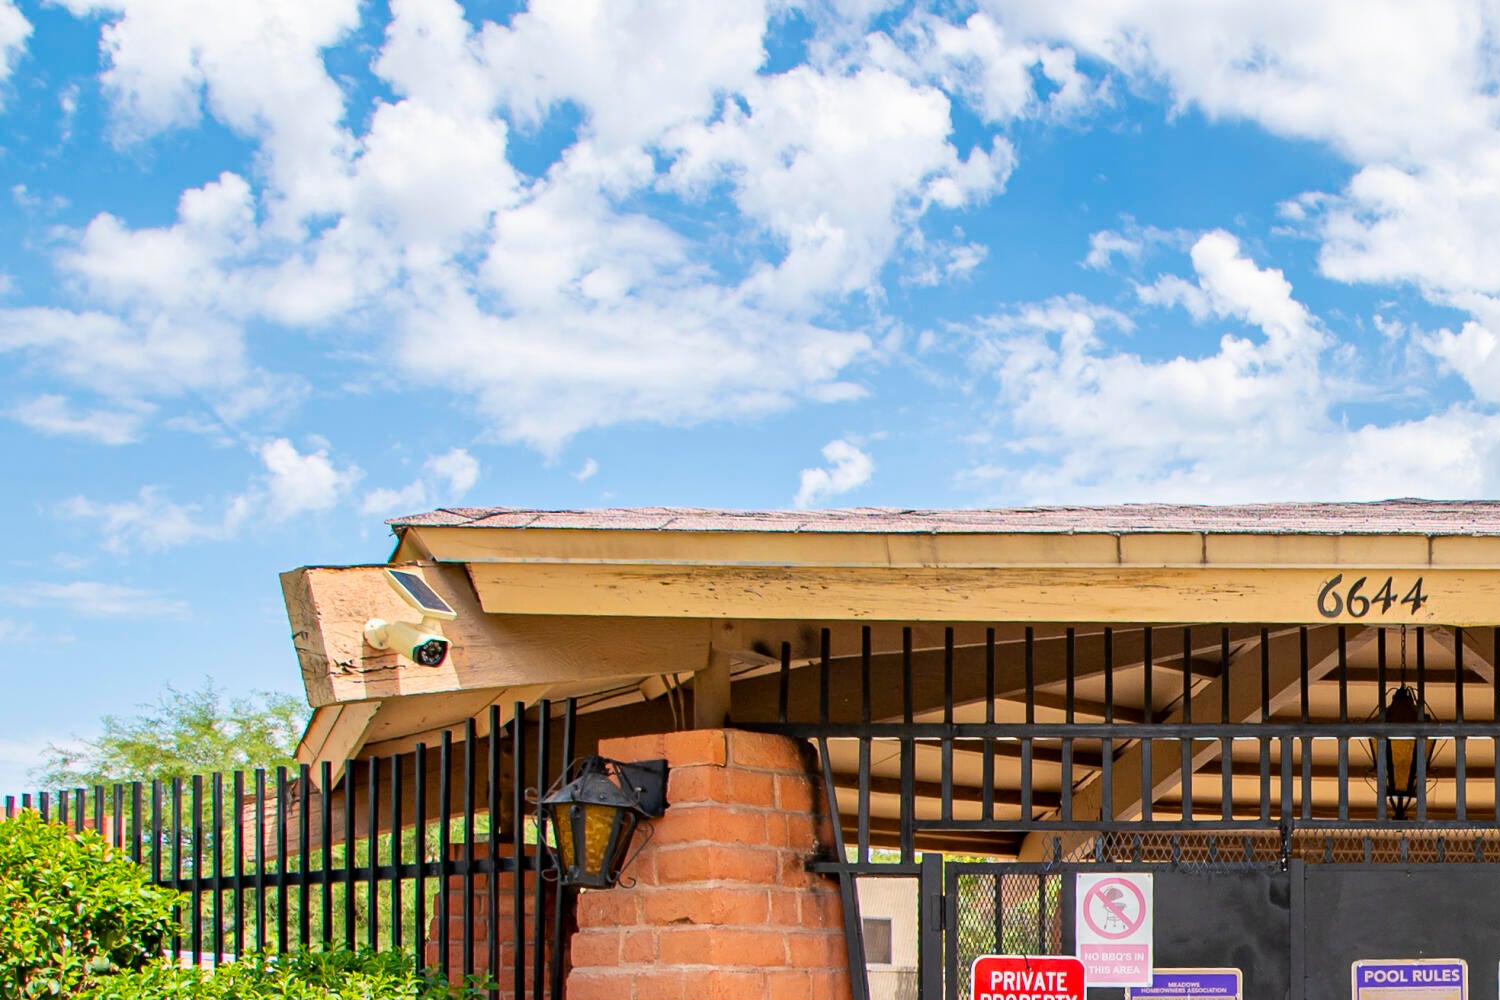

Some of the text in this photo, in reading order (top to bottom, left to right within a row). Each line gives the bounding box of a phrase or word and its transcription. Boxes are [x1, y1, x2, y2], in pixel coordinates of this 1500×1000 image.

[1317, 573, 1428, 618] 6644
[1084, 952, 1145, 961] NO BBQ'S IN
[1089, 965, 1140, 975] THIS AREA
[1364, 969, 1460, 983] POOL RULES
[990, 971, 1068, 992] PRIVATE
